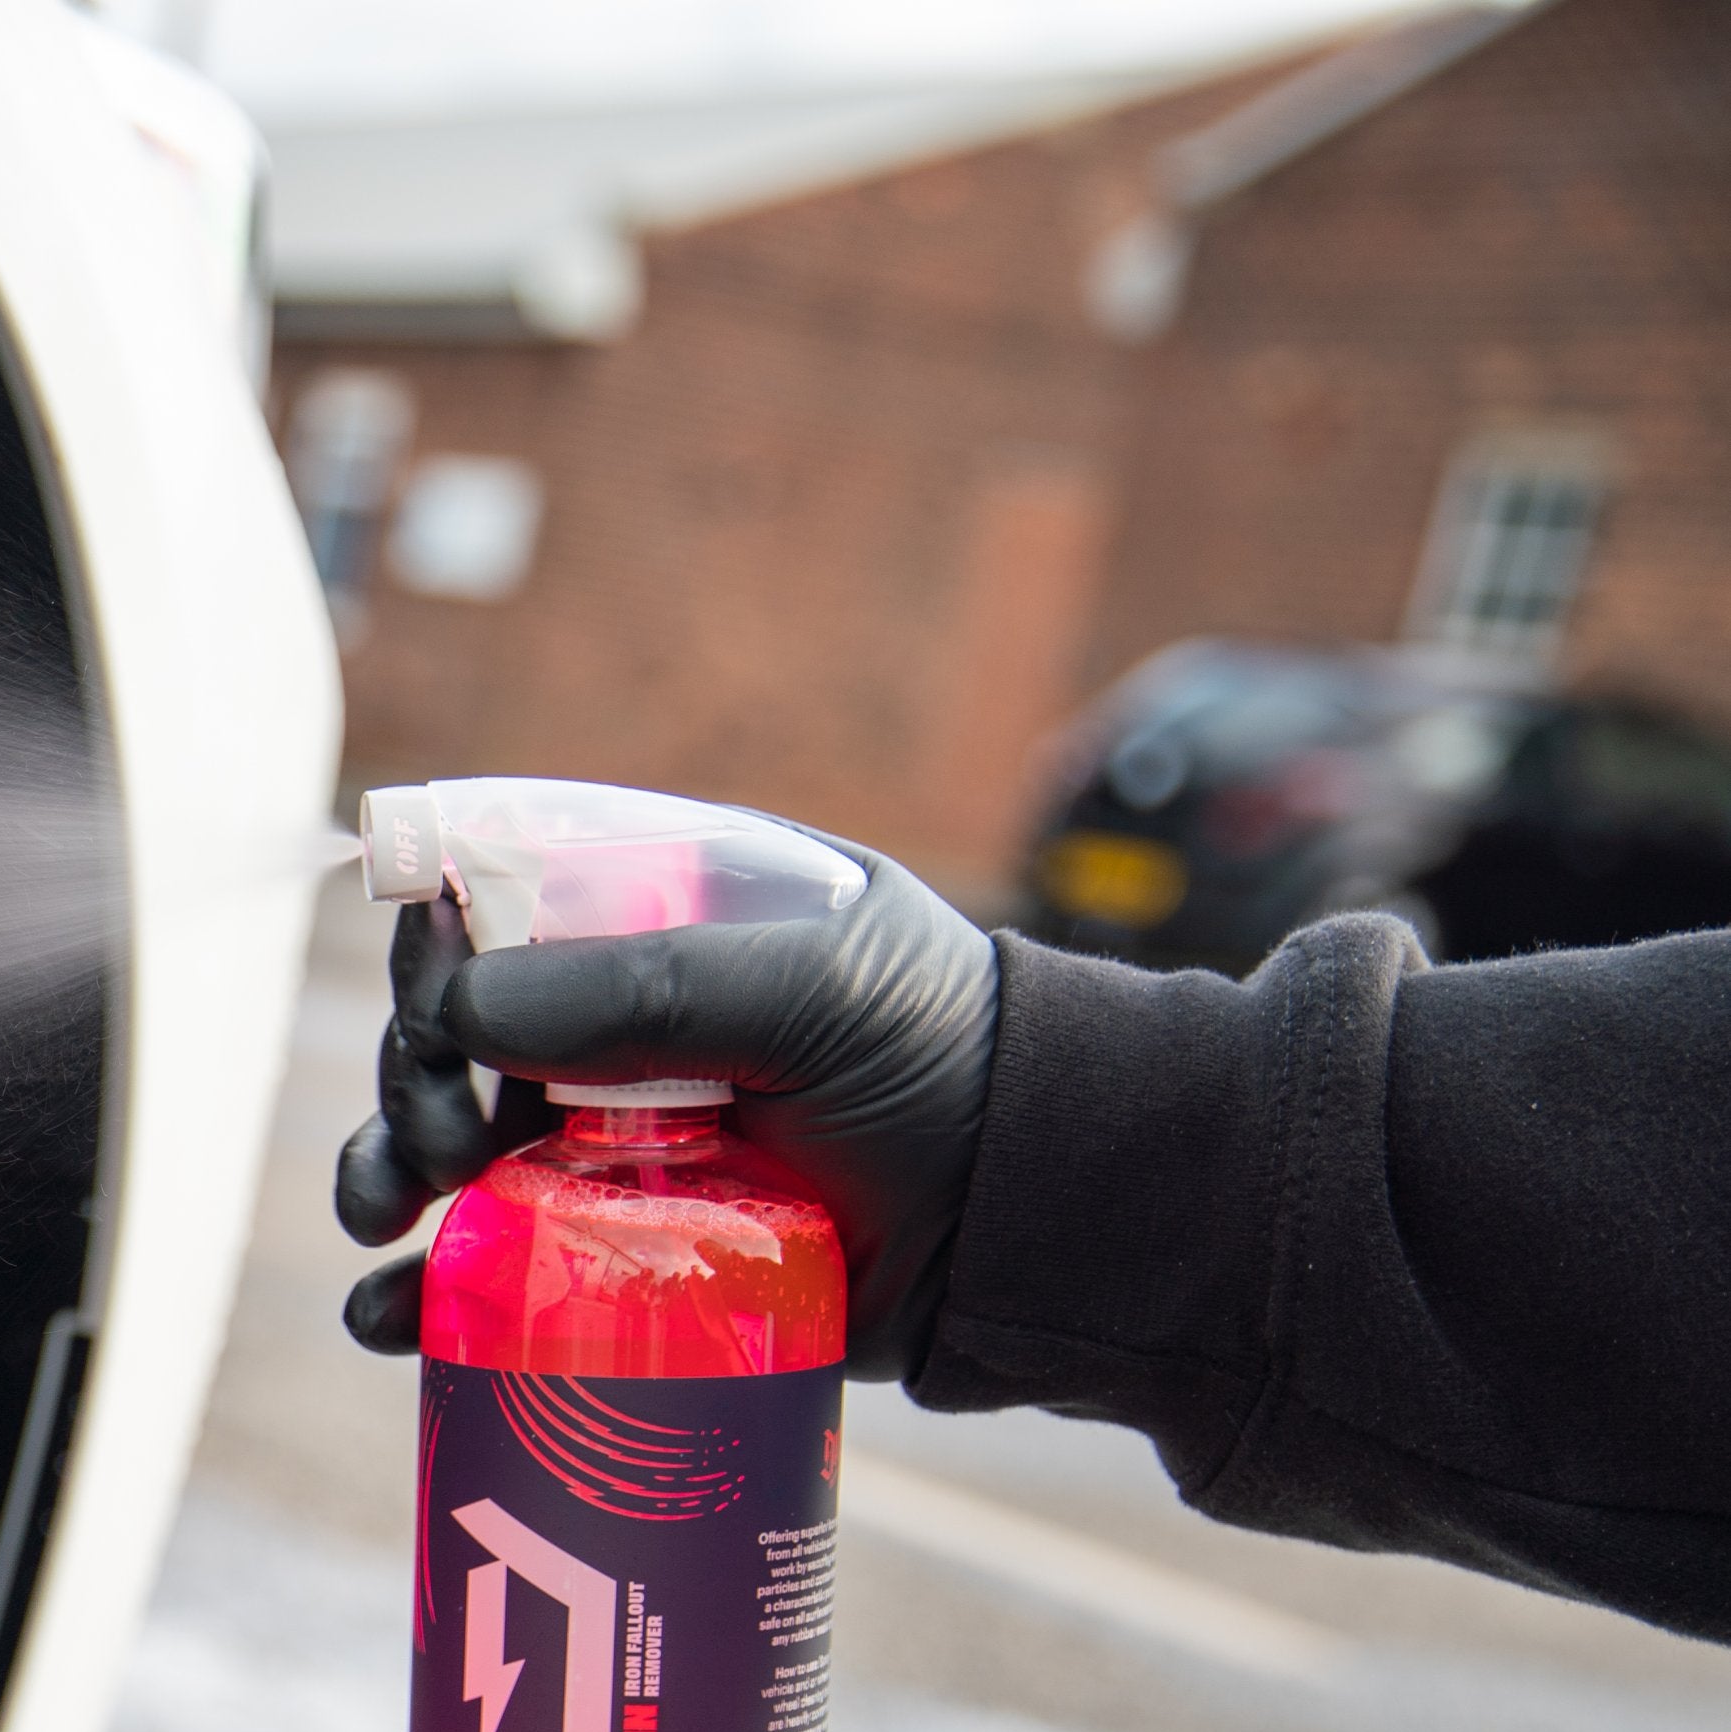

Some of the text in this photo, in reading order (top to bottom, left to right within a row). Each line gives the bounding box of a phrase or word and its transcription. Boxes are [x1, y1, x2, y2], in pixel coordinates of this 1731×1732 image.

[393, 816, 419, 875] OFF
[758, 1529, 799, 1545] Offering
[766, 1547, 791, 1561] from
[792, 1544, 803, 1558] all
[771, 1562, 795, 1578] work
[796, 1561, 807, 1575] by
[757, 1579, 799, 1599] particles
[764, 1603, 771, 1613] a
[759, 1616, 781, 1631] safe
[782, 1617, 795, 1628] on
[795, 1610, 806, 1625] all
[624, 1581, 645, 1697] IRON FALLOUT
[771, 1632, 790, 1647] any
[643, 1615, 663, 1697] REMOVER
[775, 1665, 796, 1679] How
[761, 1681, 794, 1699] vehicle
[768, 1718, 784, 1732] are
